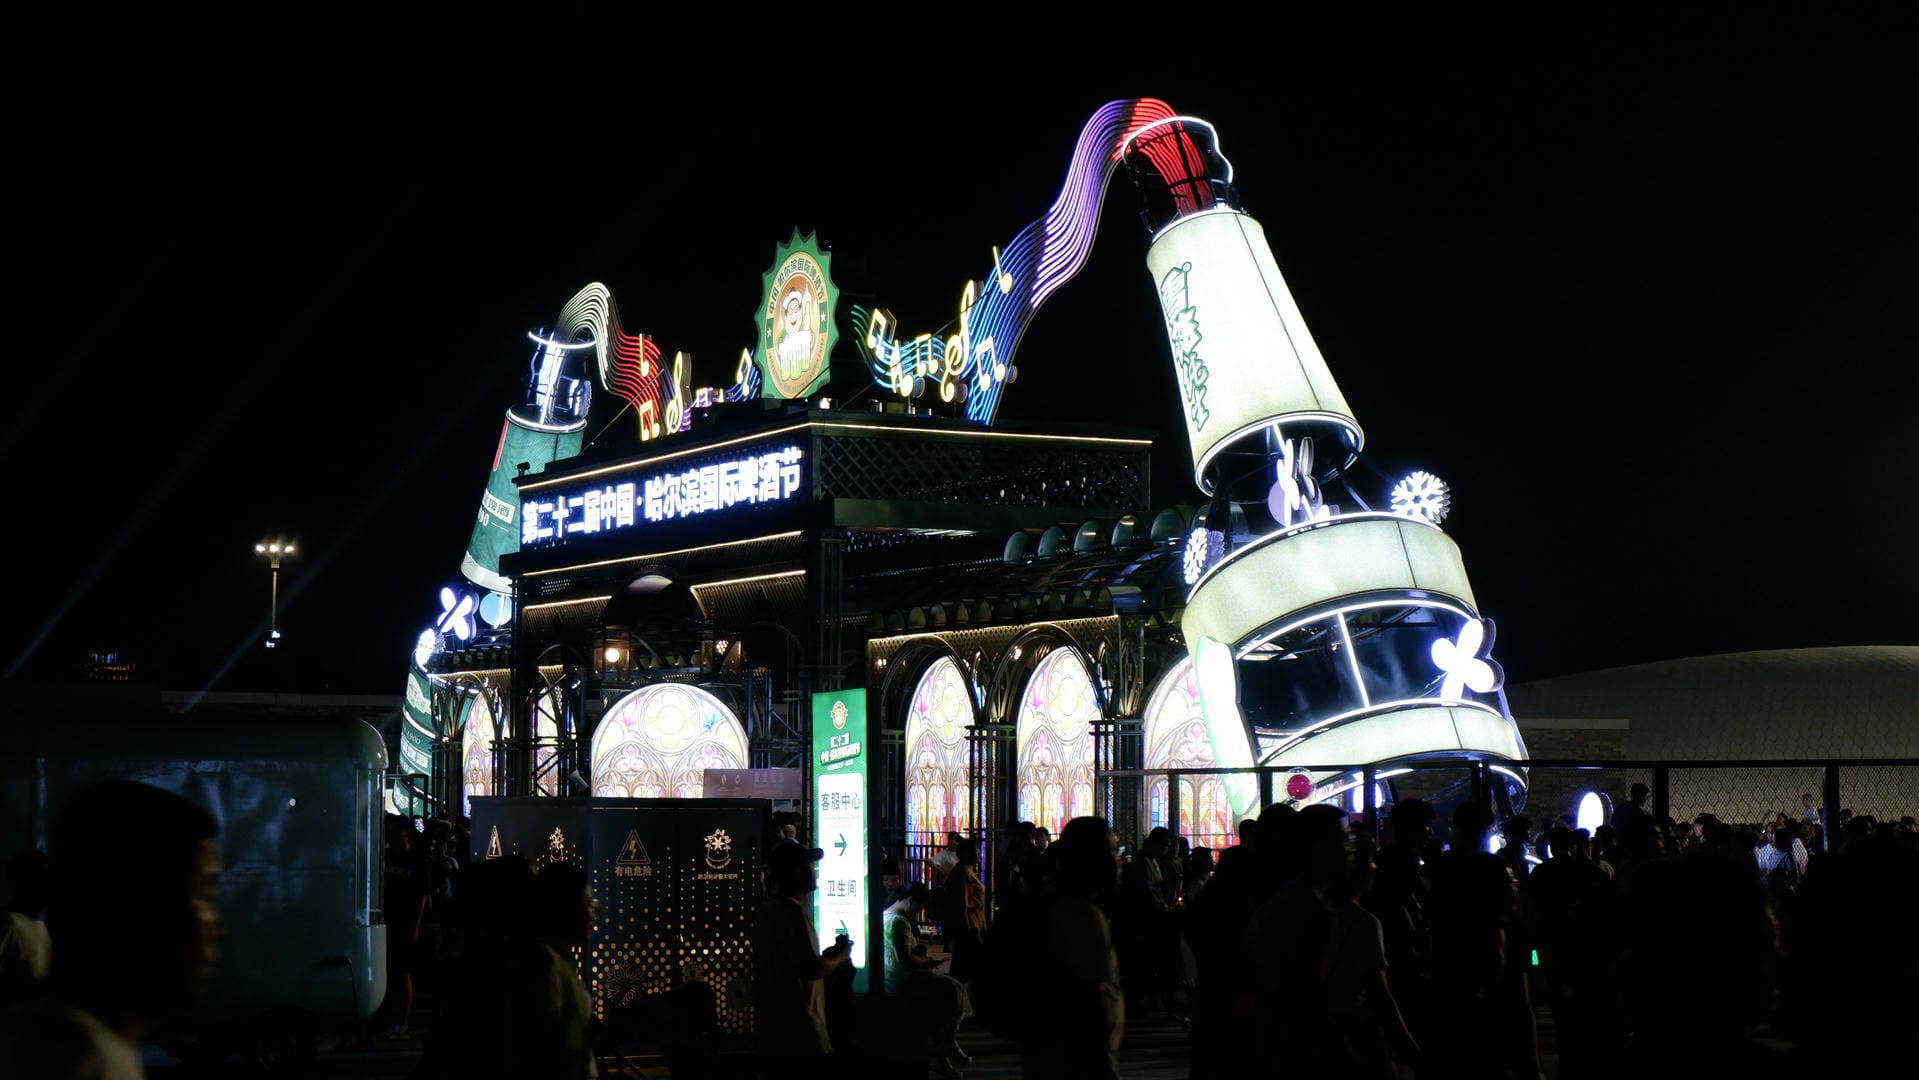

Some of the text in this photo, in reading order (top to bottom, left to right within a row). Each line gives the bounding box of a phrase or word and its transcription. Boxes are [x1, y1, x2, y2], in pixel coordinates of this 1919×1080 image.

[821, 791, 862, 811] 客服中心
[614, 865, 653, 877] 有电危险
[827, 879, 857, 897] 卫生间
